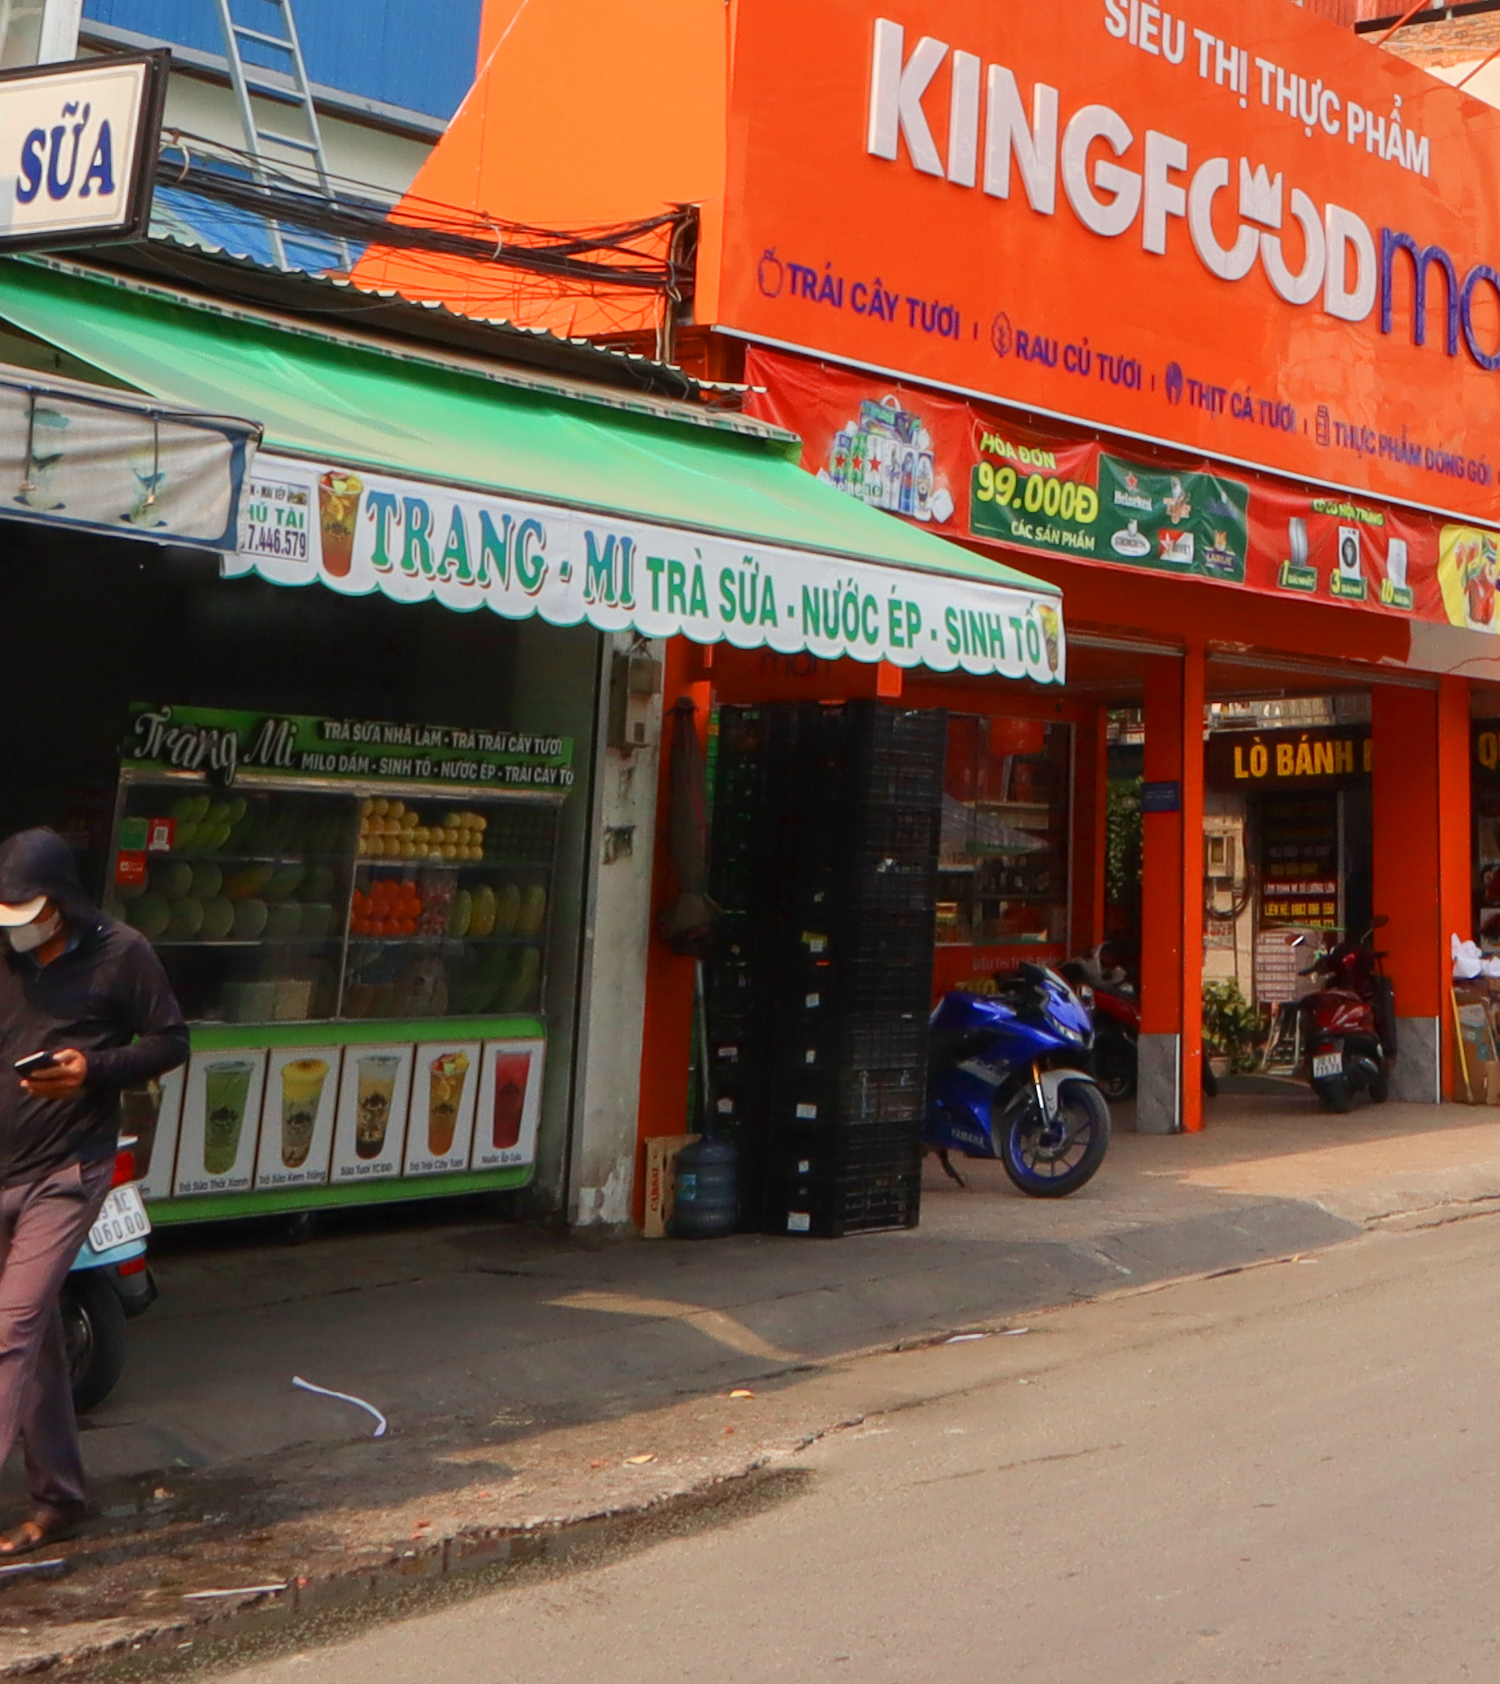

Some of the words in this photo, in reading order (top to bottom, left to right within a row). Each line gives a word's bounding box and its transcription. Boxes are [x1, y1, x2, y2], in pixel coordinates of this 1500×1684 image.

[1192, 25, 1251, 109] THỊ
[1255, 55, 1341, 139] THỰC
[1347, 92, 1431, 180] PHẨM
[16, 101, 115, 204] SỮA
[787, 262, 844, 307] TRÁI
[851, 277, 899, 321] CÂY
[906, 296, 960, 340] TƯƠI
[1016, 330, 1058, 368] RAU
[1063, 337, 1091, 376] CỦ
[1097, 352, 1142, 391] TƯƠI
[1187, 378, 1225, 419] THỊT
[1230, 386, 1253, 420] CÁ
[1257, 398, 1296, 432] TƯƠI
[275, 506, 304, 529] TÀI
[976, 461, 1098, 524] 99.000Đ
[366, 490, 547, 594] TRANG
[582, 529, 636, 610] MI
[646, 546, 708, 621] TRÀ
[719, 556, 778, 628] SỮA
[802, 581, 879, 646] NƯỚC
[888, 592, 923, 650] ÉP
[945, 610, 1006, 661] SINH
[1012, 601, 1041, 667] TỐ
[244, 717, 297, 767] Mi
[324, 719, 350, 742] TRÀ
[1234, 737, 1269, 779] LÒ
[1277, 734, 1353, 776] BÁNH
[301, 753, 337, 772] MILO
[380, 755, 409, 777] SINH
